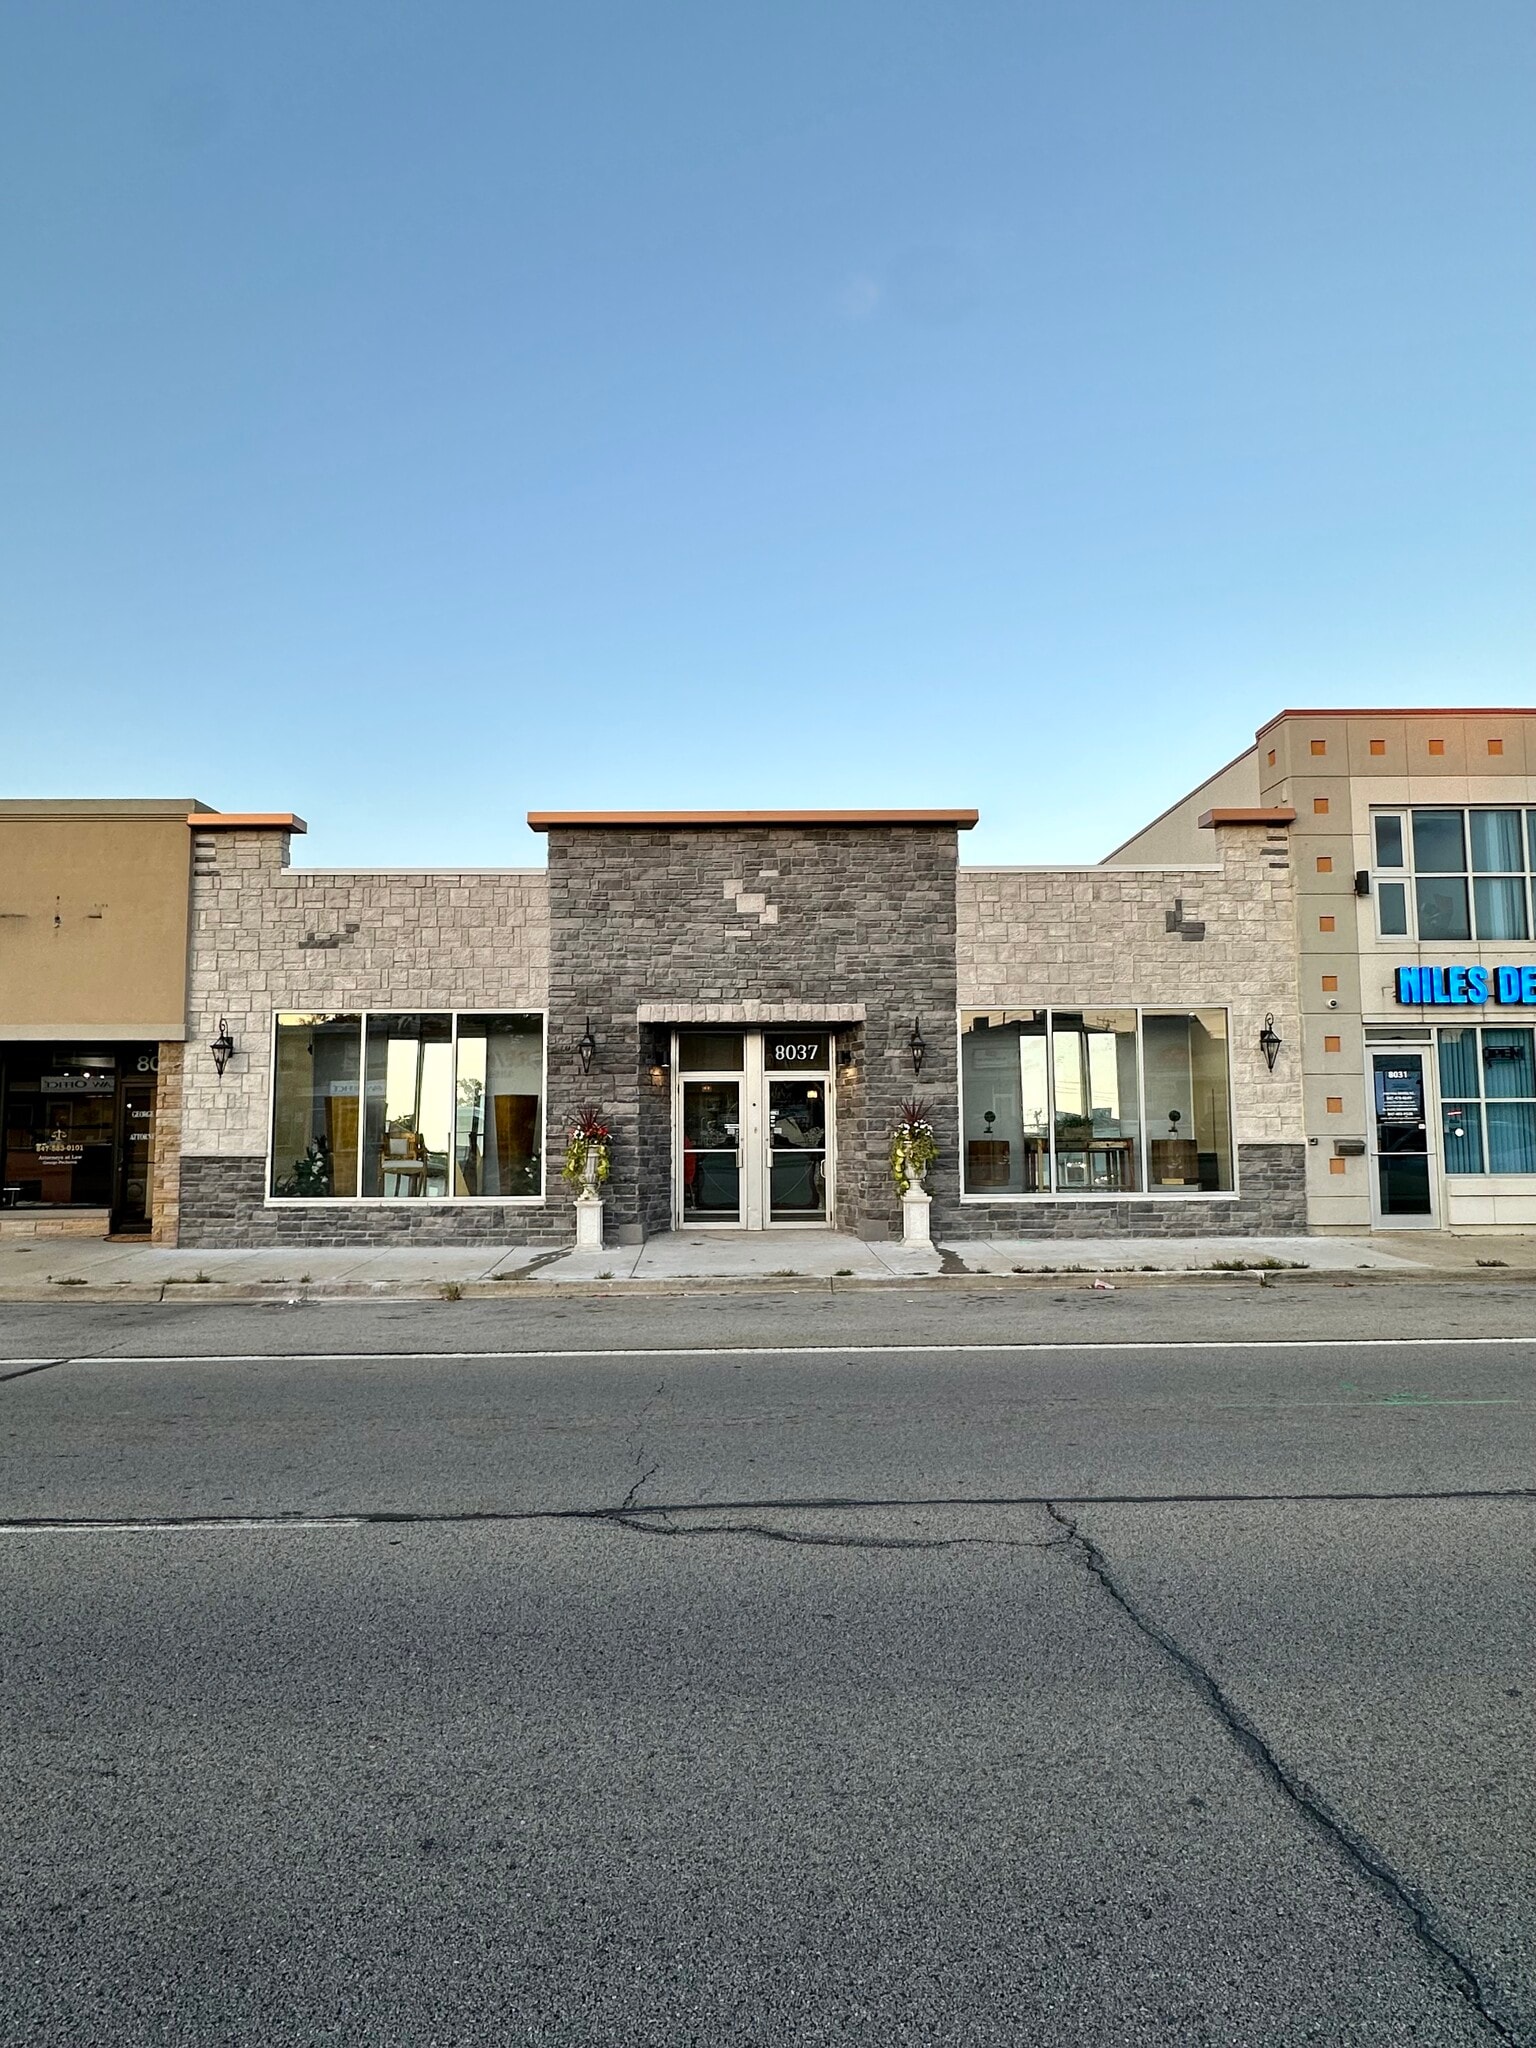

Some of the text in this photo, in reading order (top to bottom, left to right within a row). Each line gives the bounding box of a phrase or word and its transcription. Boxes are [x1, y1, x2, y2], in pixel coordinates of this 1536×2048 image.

[1394, 965, 1489, 1005] NILES
[775, 1044, 818, 1060] 8037
[1388, 1071, 1408, 1079] 8031
